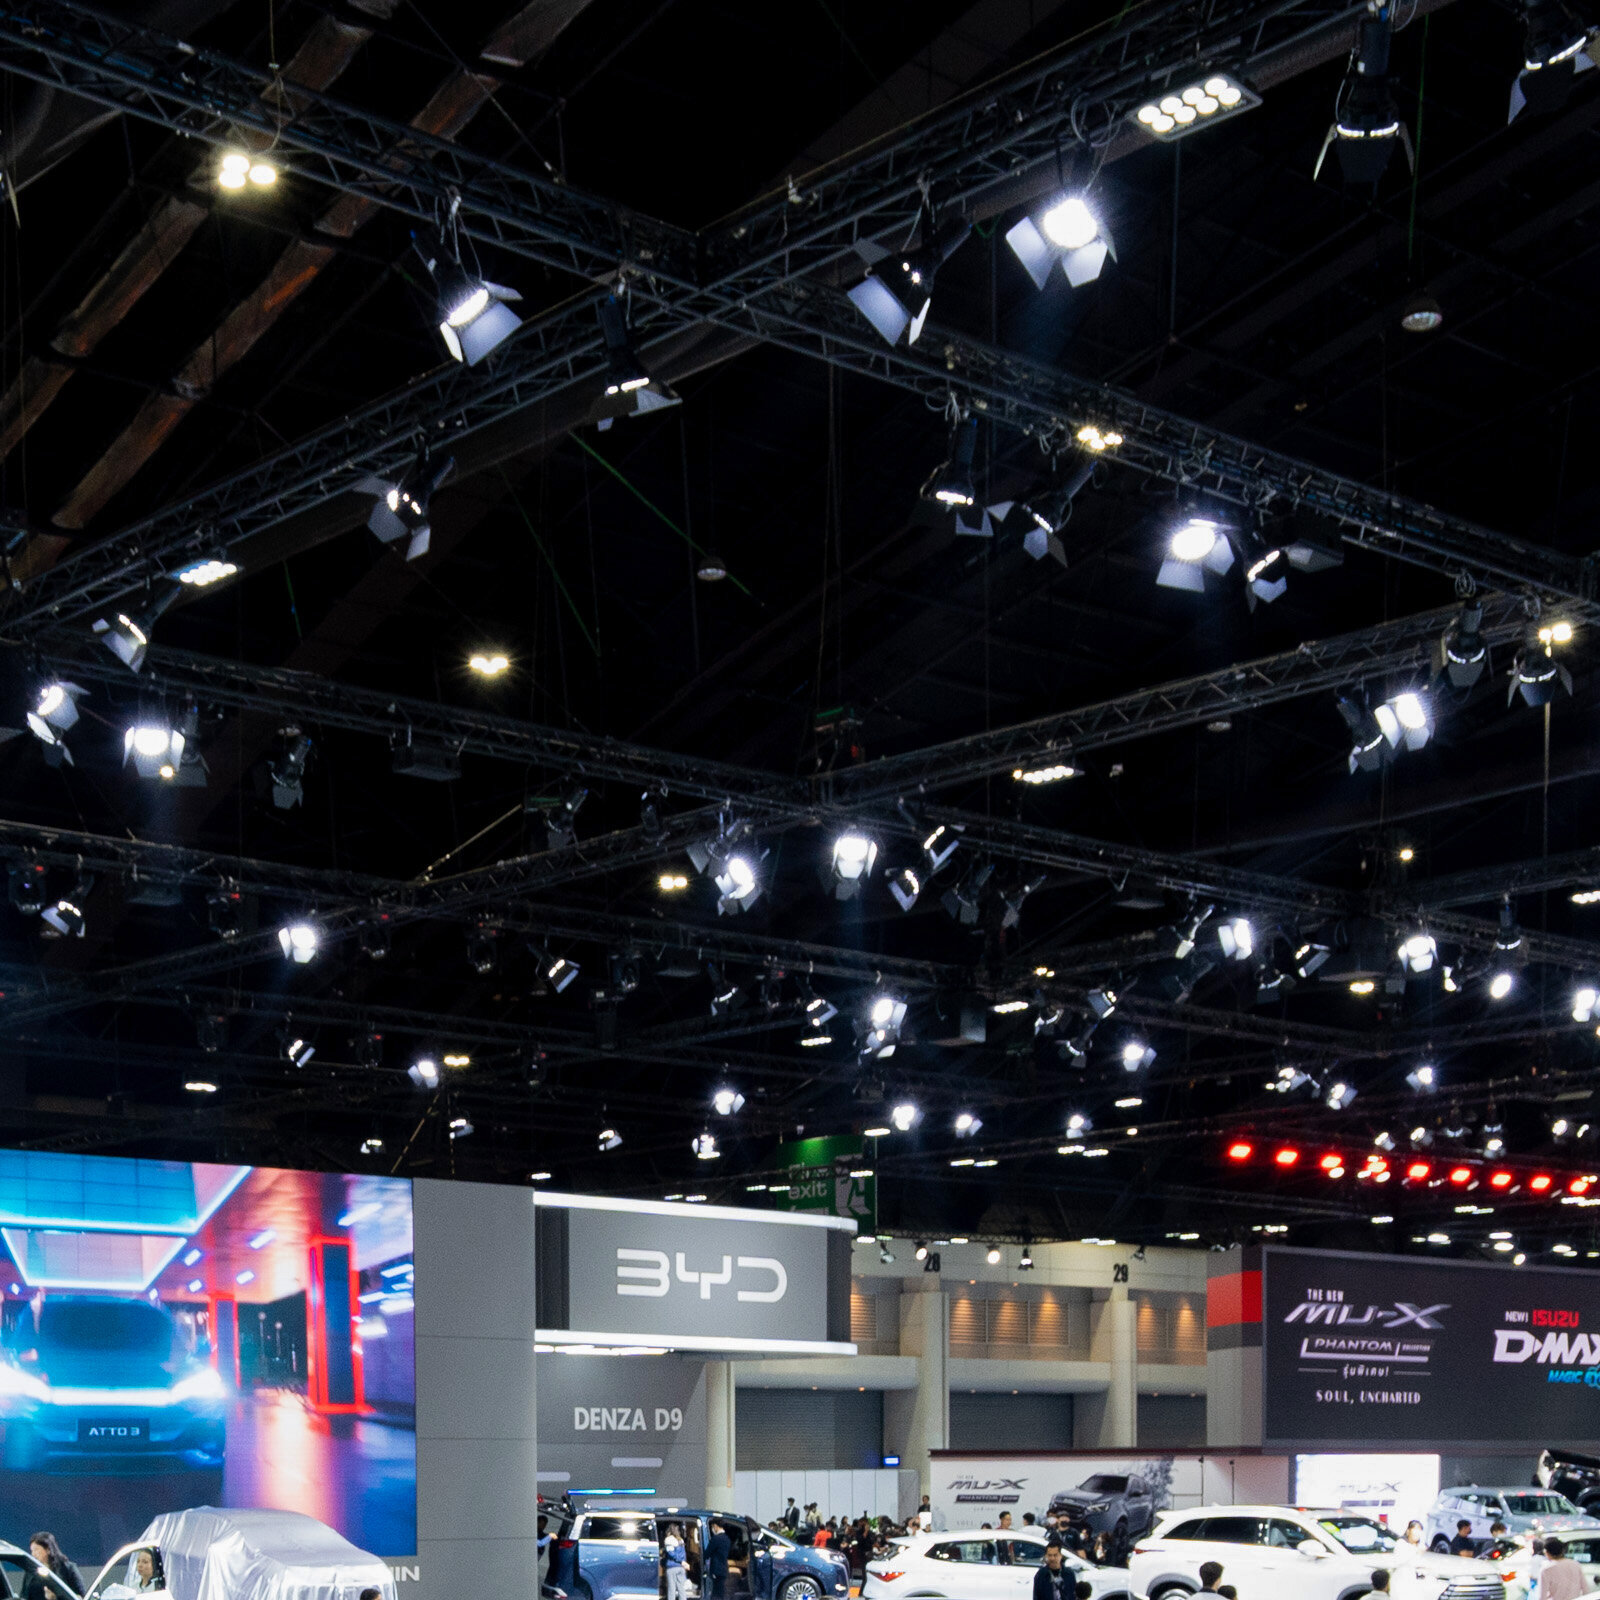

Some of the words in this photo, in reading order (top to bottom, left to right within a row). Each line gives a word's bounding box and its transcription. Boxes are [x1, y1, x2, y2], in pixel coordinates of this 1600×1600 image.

[788, 1181, 828, 1200] exit
[924, 1252, 941, 1272] 28
[617, 1247, 788, 1303] BYD
[1113, 1263, 1129, 1283] 29
[1307, 1288, 1323, 1301] THE
[1326, 1290, 1344, 1302] NEW
[1284, 1302, 1452, 1329] MU-X
[1532, 1309, 1580, 1328] ISUZU
[1314, 1338, 1392, 1351] PHANTOM
[1547, 1369, 1583, 1383] MAGIC
[1316, 1389, 1354, 1404] SOUL,
[1360, 1390, 1421, 1404] UNCHARTED
[573, 1407, 646, 1431] DENZA
[654, 1407, 683, 1431] D9
[89, 1427, 127, 1436] ATTO
[130, 1427, 140, 1436] 3
[947, 1478, 1029, 1490] MU-X
